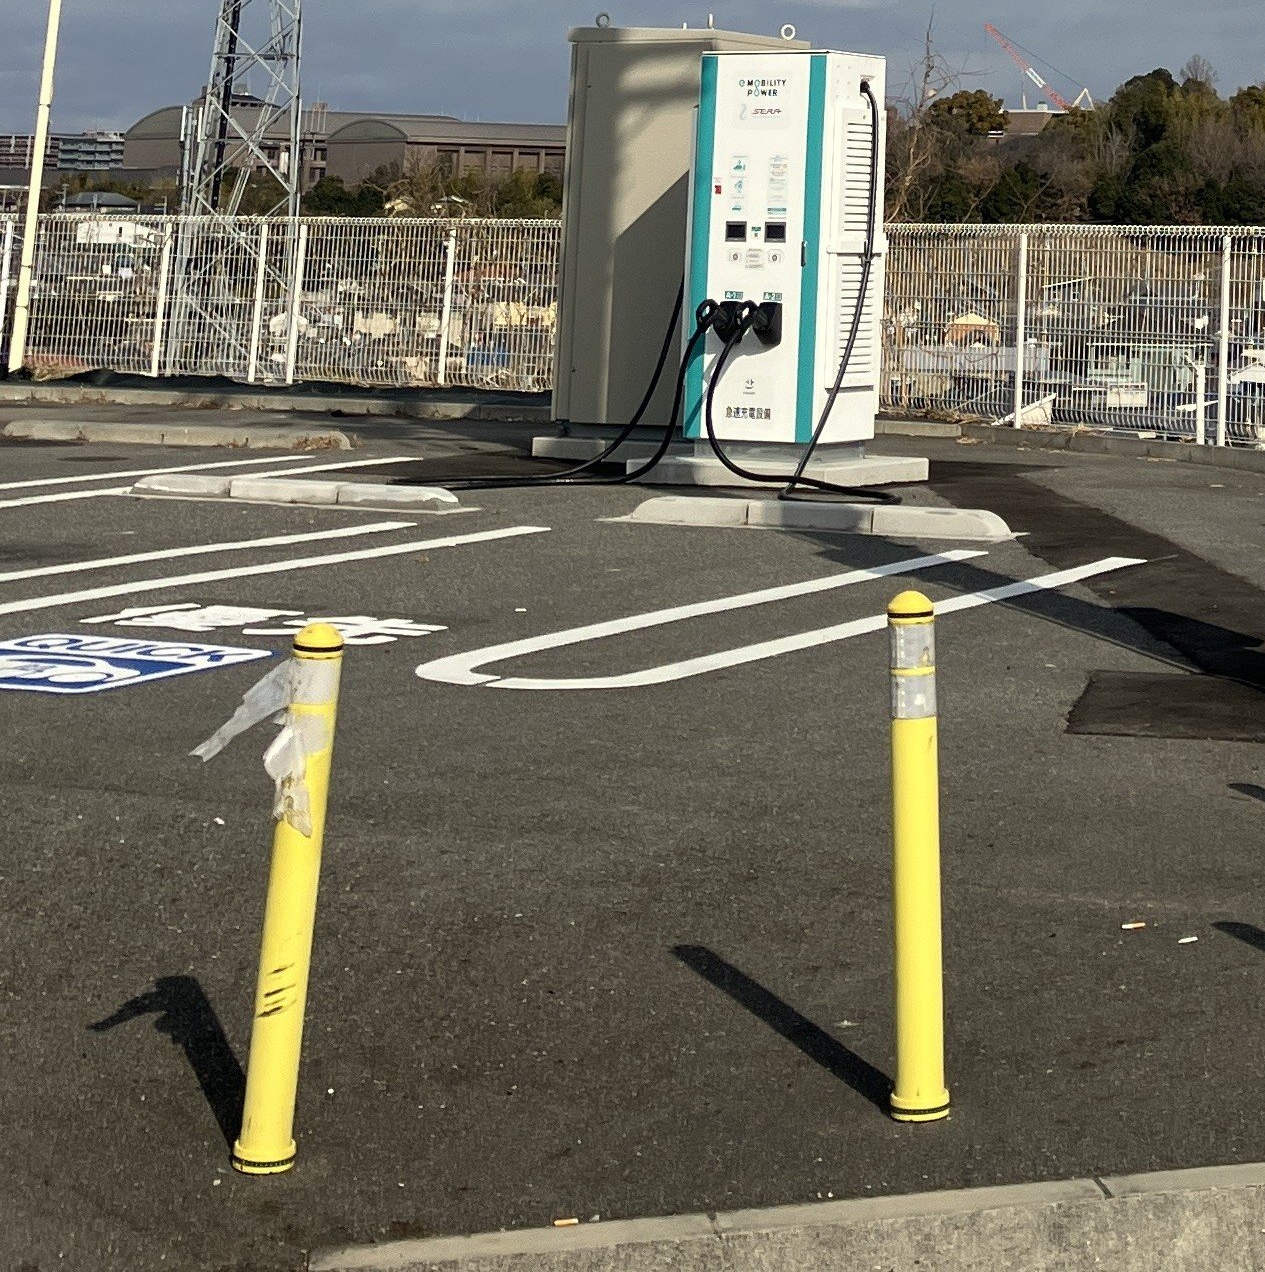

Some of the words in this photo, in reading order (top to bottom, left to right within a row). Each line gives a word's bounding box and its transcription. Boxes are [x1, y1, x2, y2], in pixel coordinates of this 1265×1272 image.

[747, 79, 786, 88] MOBILITY
[747, 89, 778, 97] POWER
[14, 638, 254, 662] QUICK
